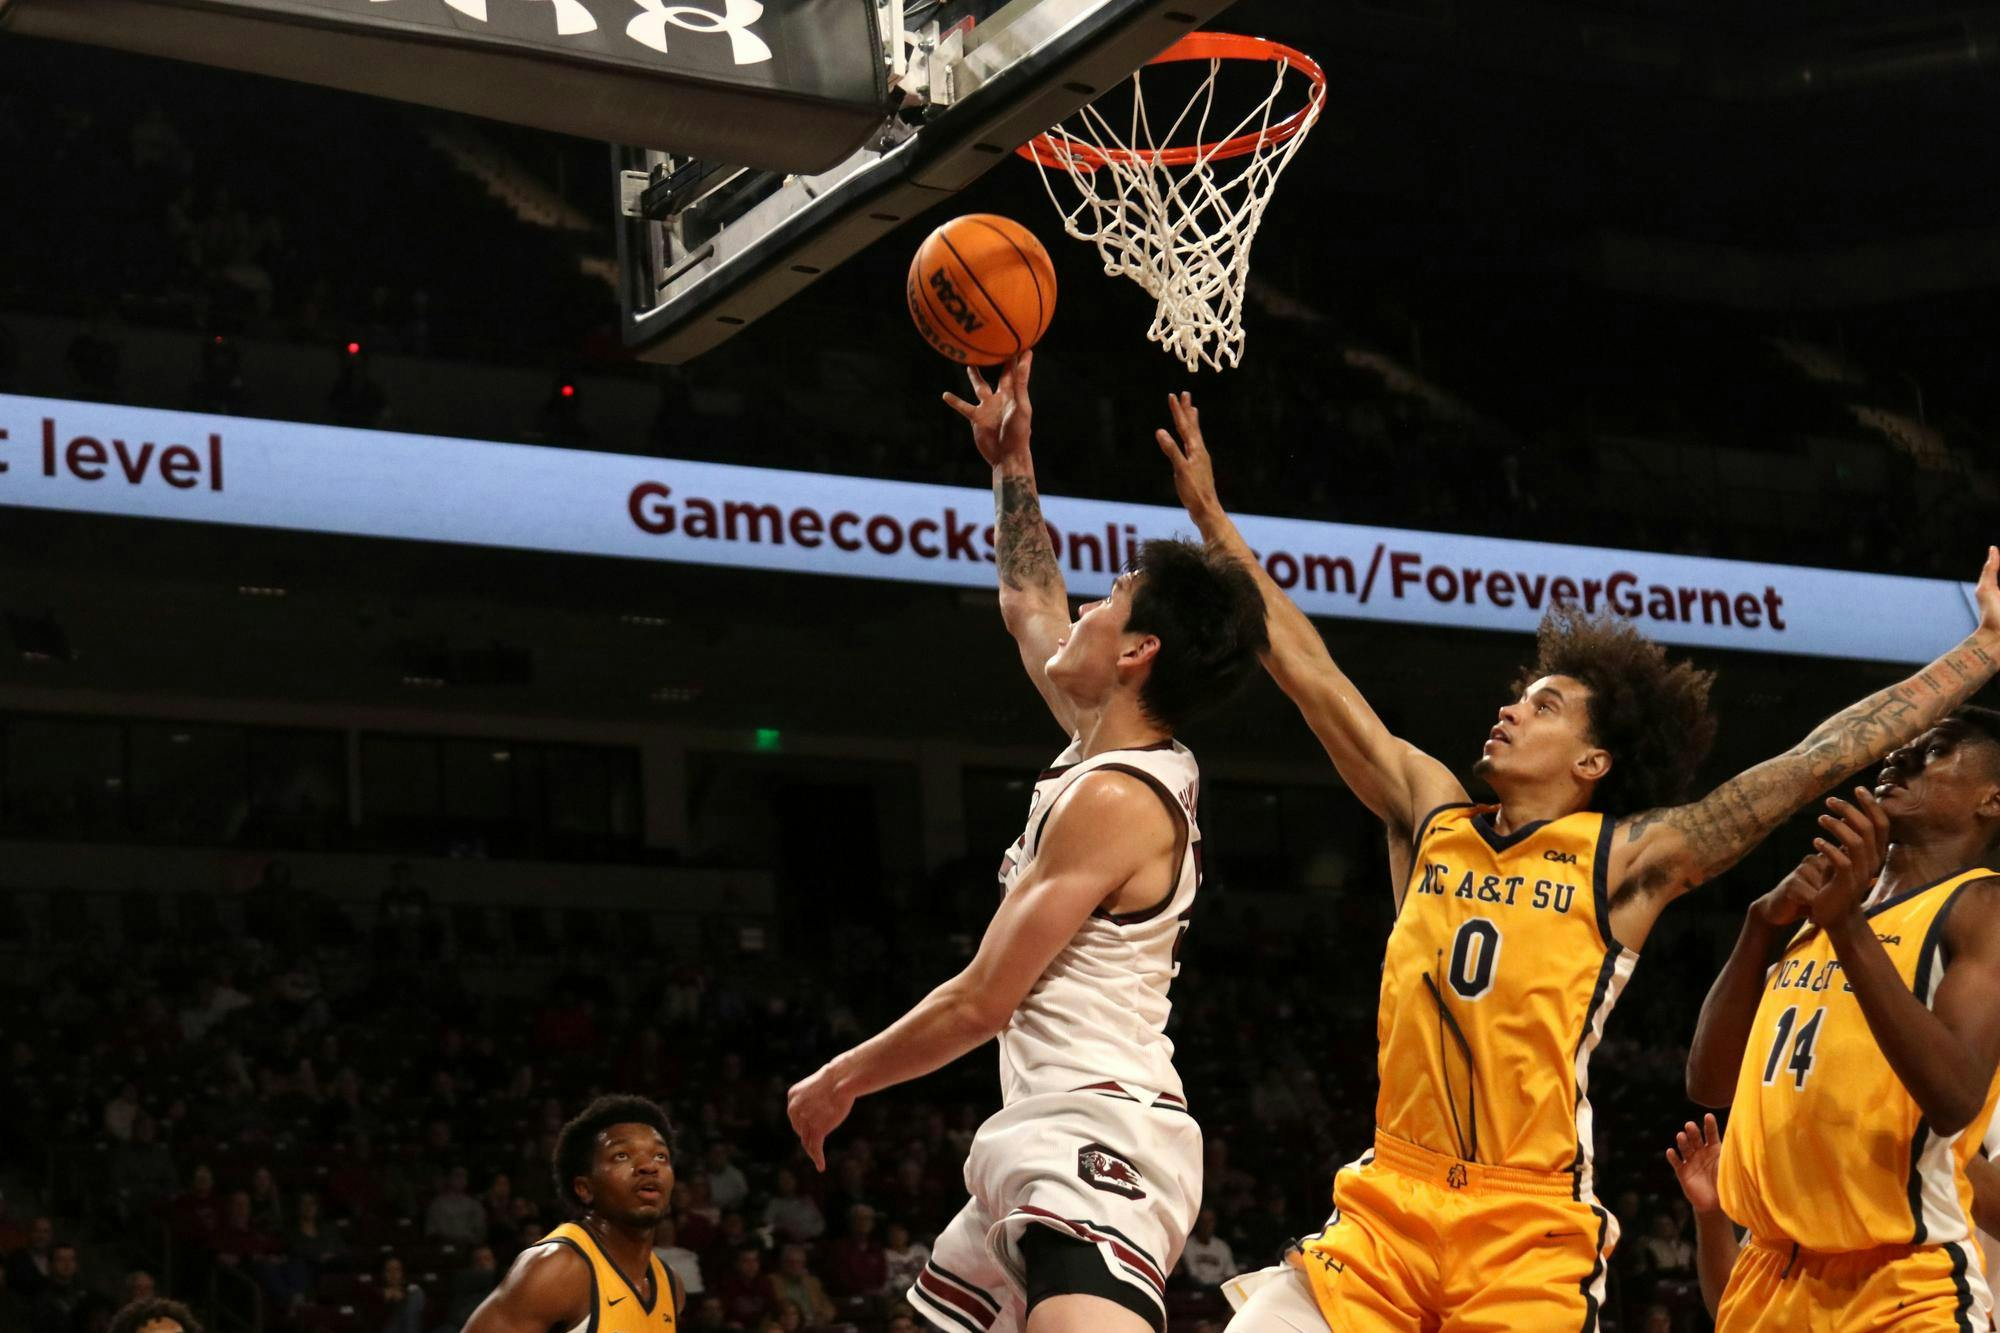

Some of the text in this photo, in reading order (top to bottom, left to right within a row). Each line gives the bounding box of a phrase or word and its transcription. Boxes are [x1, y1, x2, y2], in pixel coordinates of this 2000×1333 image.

[929, 265, 985, 334] NCAA
[42, 417, 223, 491] level
[628, 479, 1786, 631] Gamecocknliom/ForeverGarnet
[1417, 864, 1576, 914] NC A&T SU
[1543, 850, 1577, 865] CAA
[1449, 917, 1501, 1001] 0
[1762, 1005, 1827, 1091] 14
